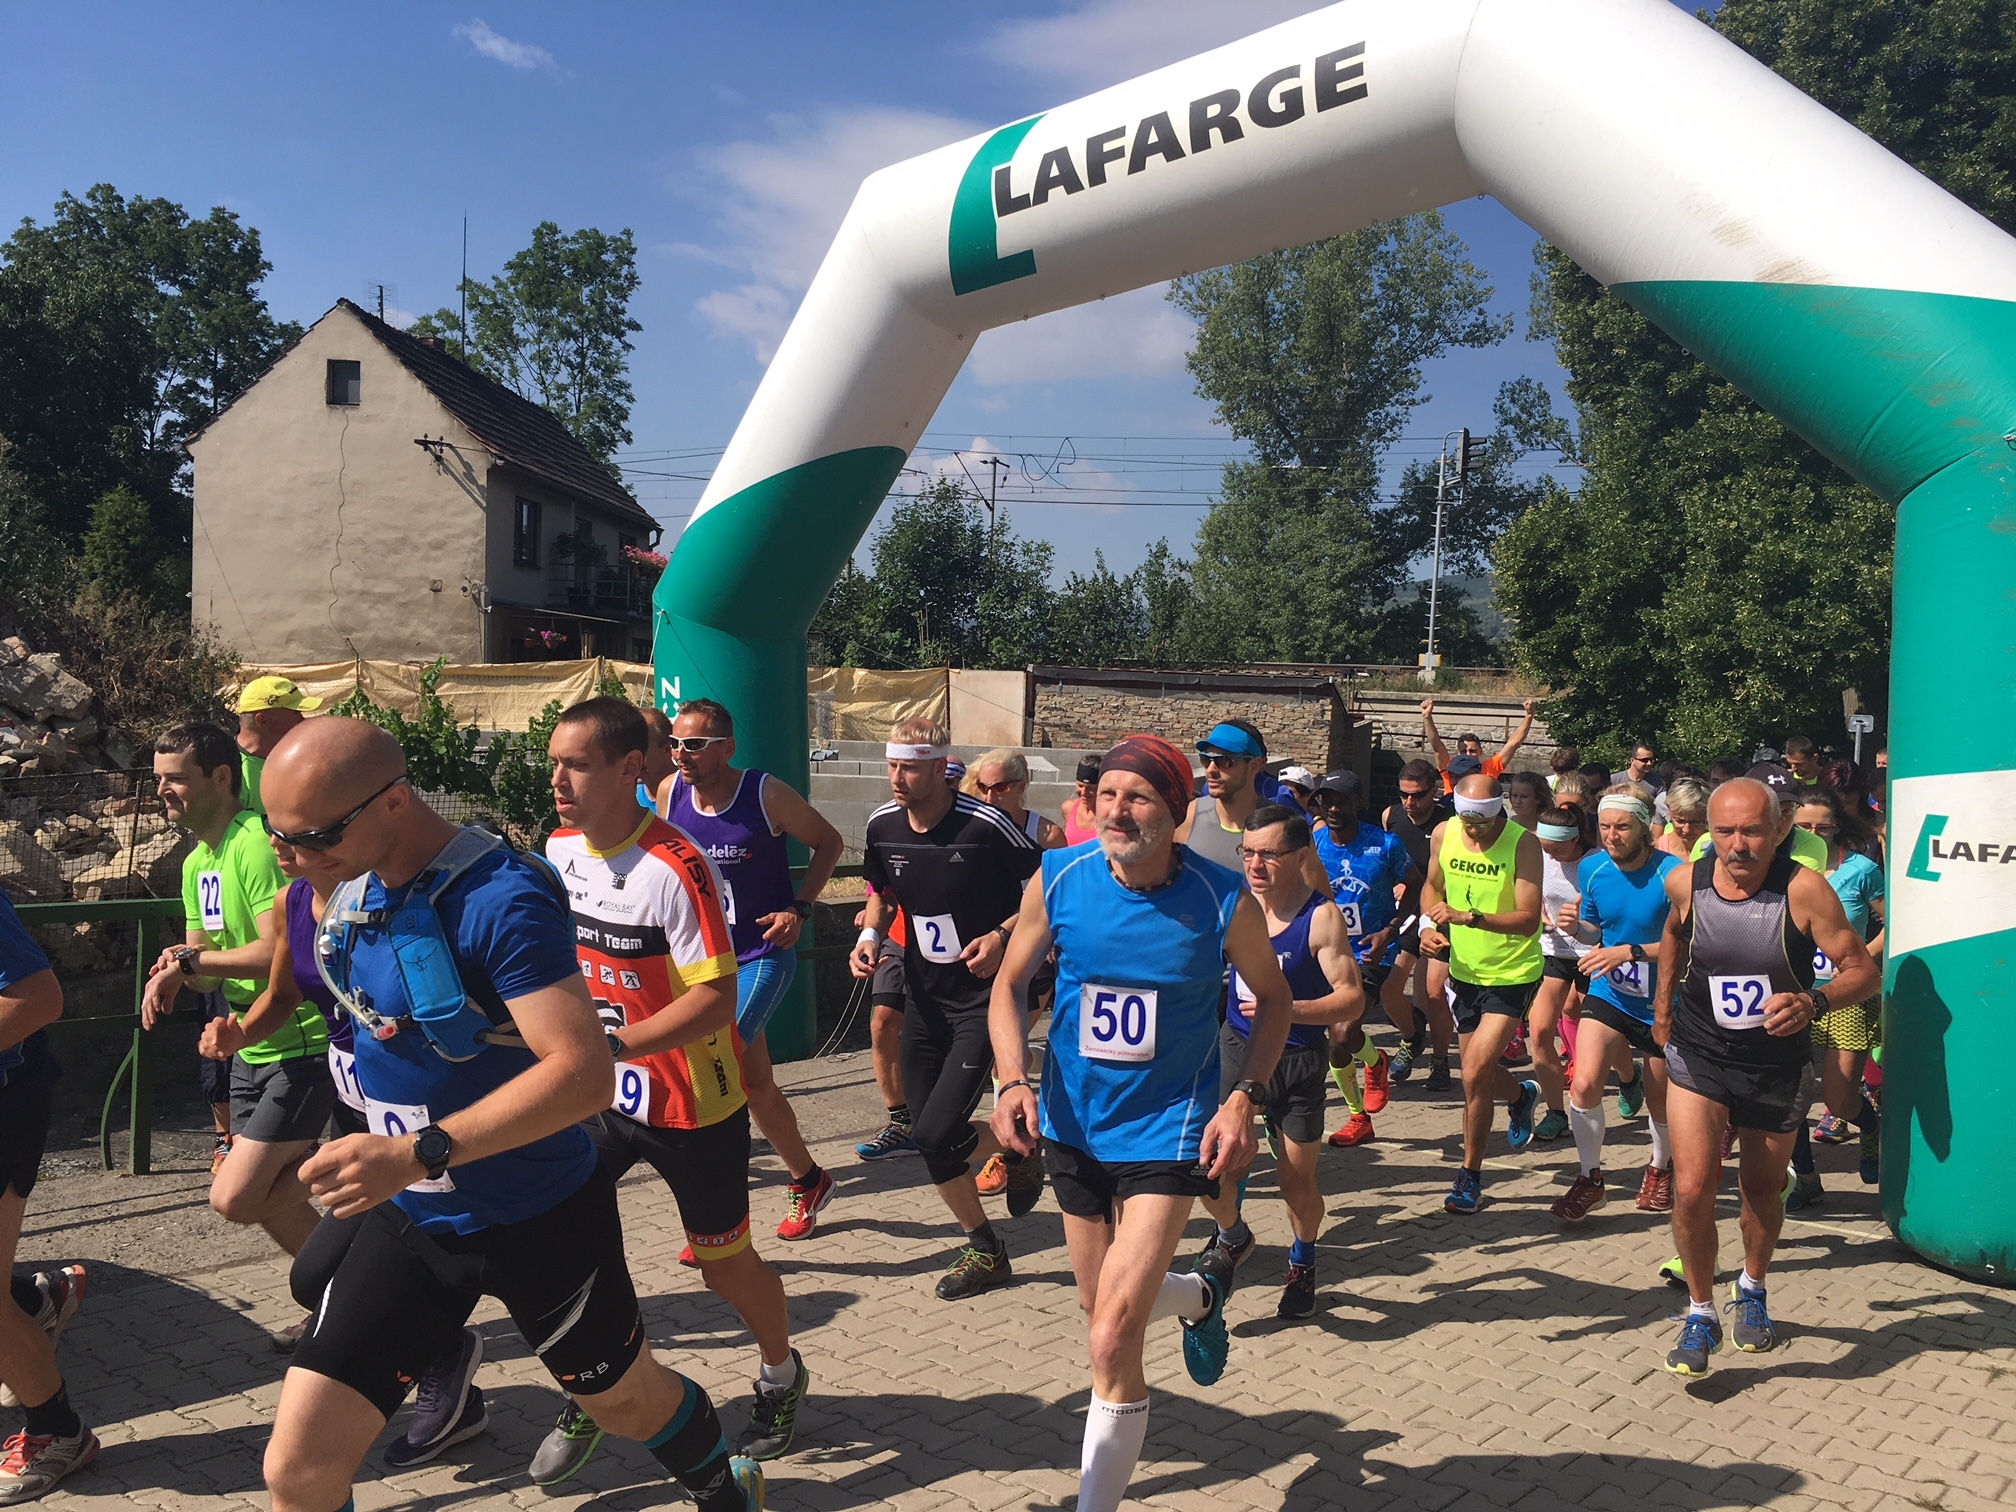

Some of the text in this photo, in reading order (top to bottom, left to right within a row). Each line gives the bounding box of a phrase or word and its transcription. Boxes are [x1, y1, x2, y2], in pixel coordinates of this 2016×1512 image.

[995, 40, 1369, 218] LAFARGE
[201, 875, 221, 916] 22
[604, 933, 644, 950] Team
[925, 921, 947, 953] 2
[1091, 991, 1147, 1046] 50
[1721, 980, 1765, 1018] 52
[618, 1069, 643, 1116] 9
[1101, 1404, 1148, 1416] moose
